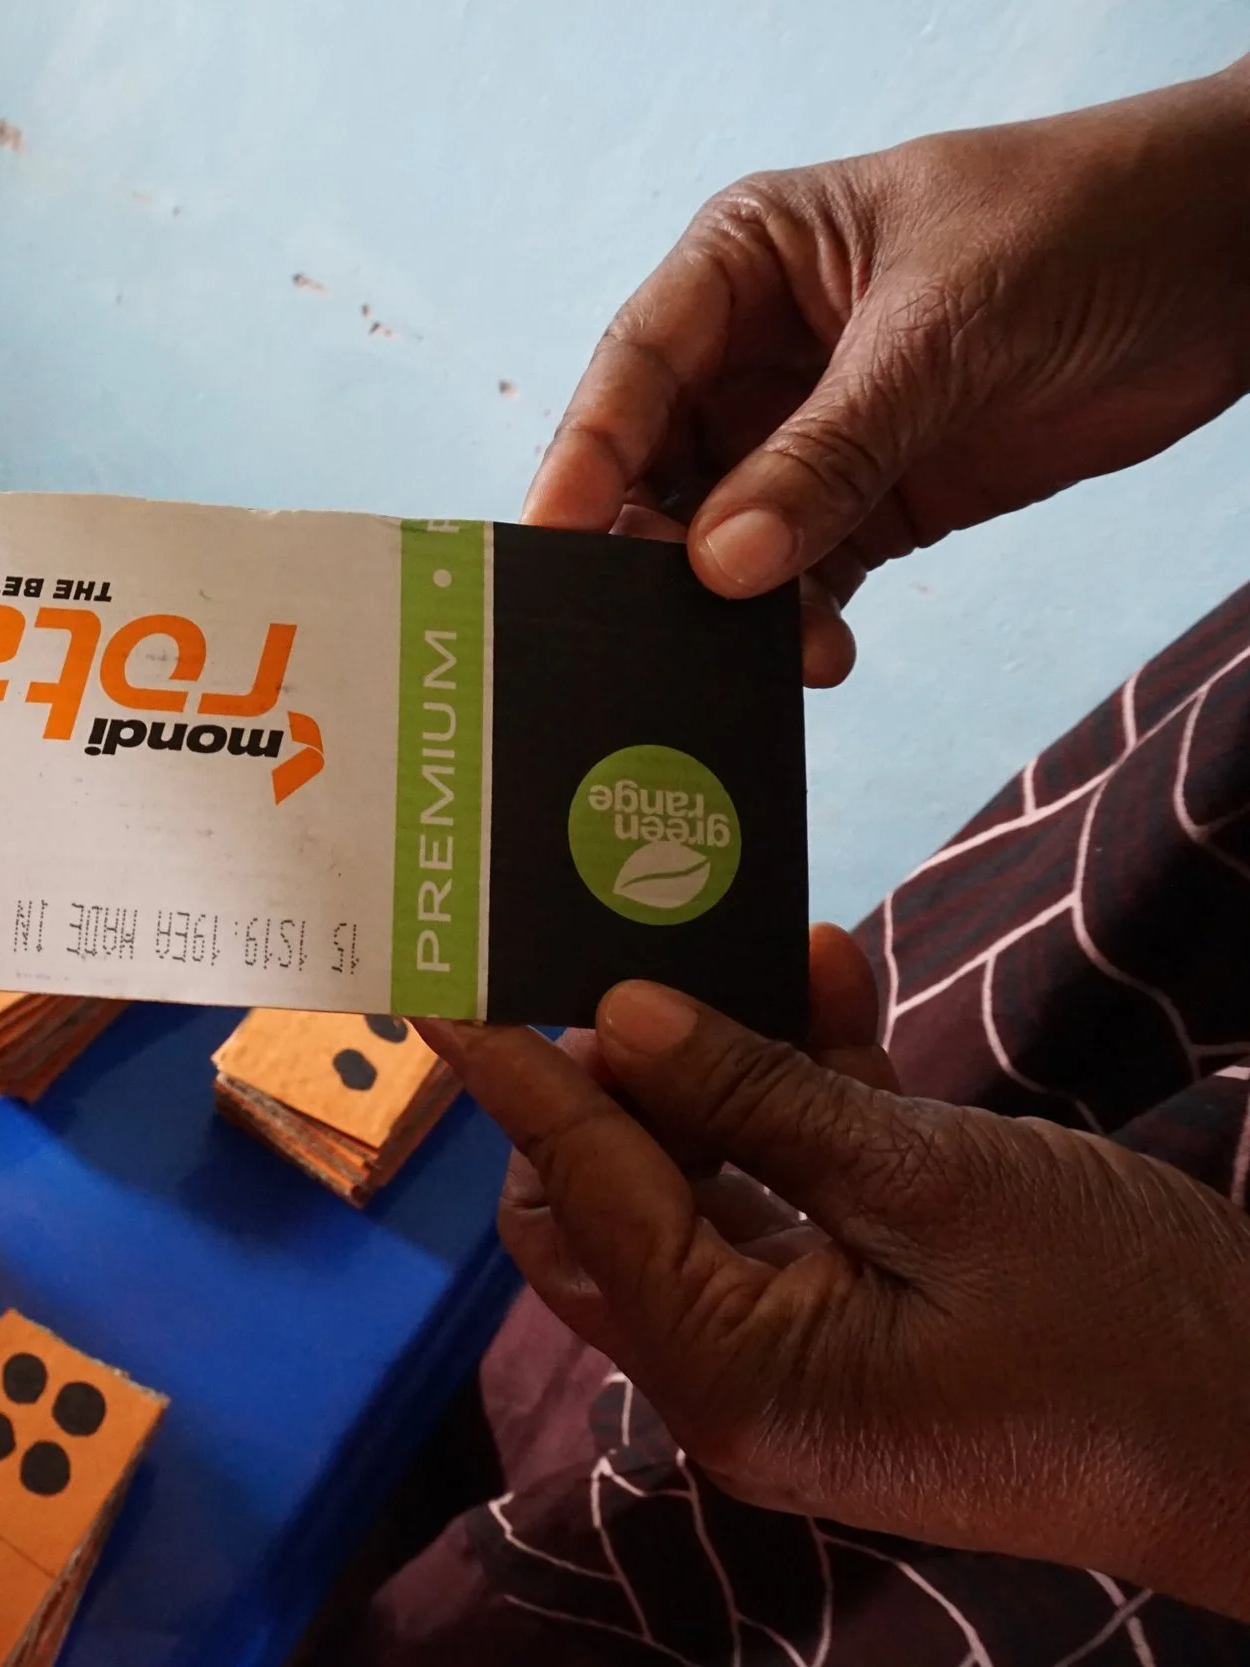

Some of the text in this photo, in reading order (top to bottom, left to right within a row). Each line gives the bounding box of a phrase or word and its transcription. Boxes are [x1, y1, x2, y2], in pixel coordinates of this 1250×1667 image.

[52, 579, 113, 603] THE
[84, 717, 285, 758] mondi
[415, 629, 459, 973] PREMIUM
[588, 779, 705, 818] range
[614, 813, 732, 848] green
[13, 899, 49, 952] IN
[66, 903, 138, 960] MADE
